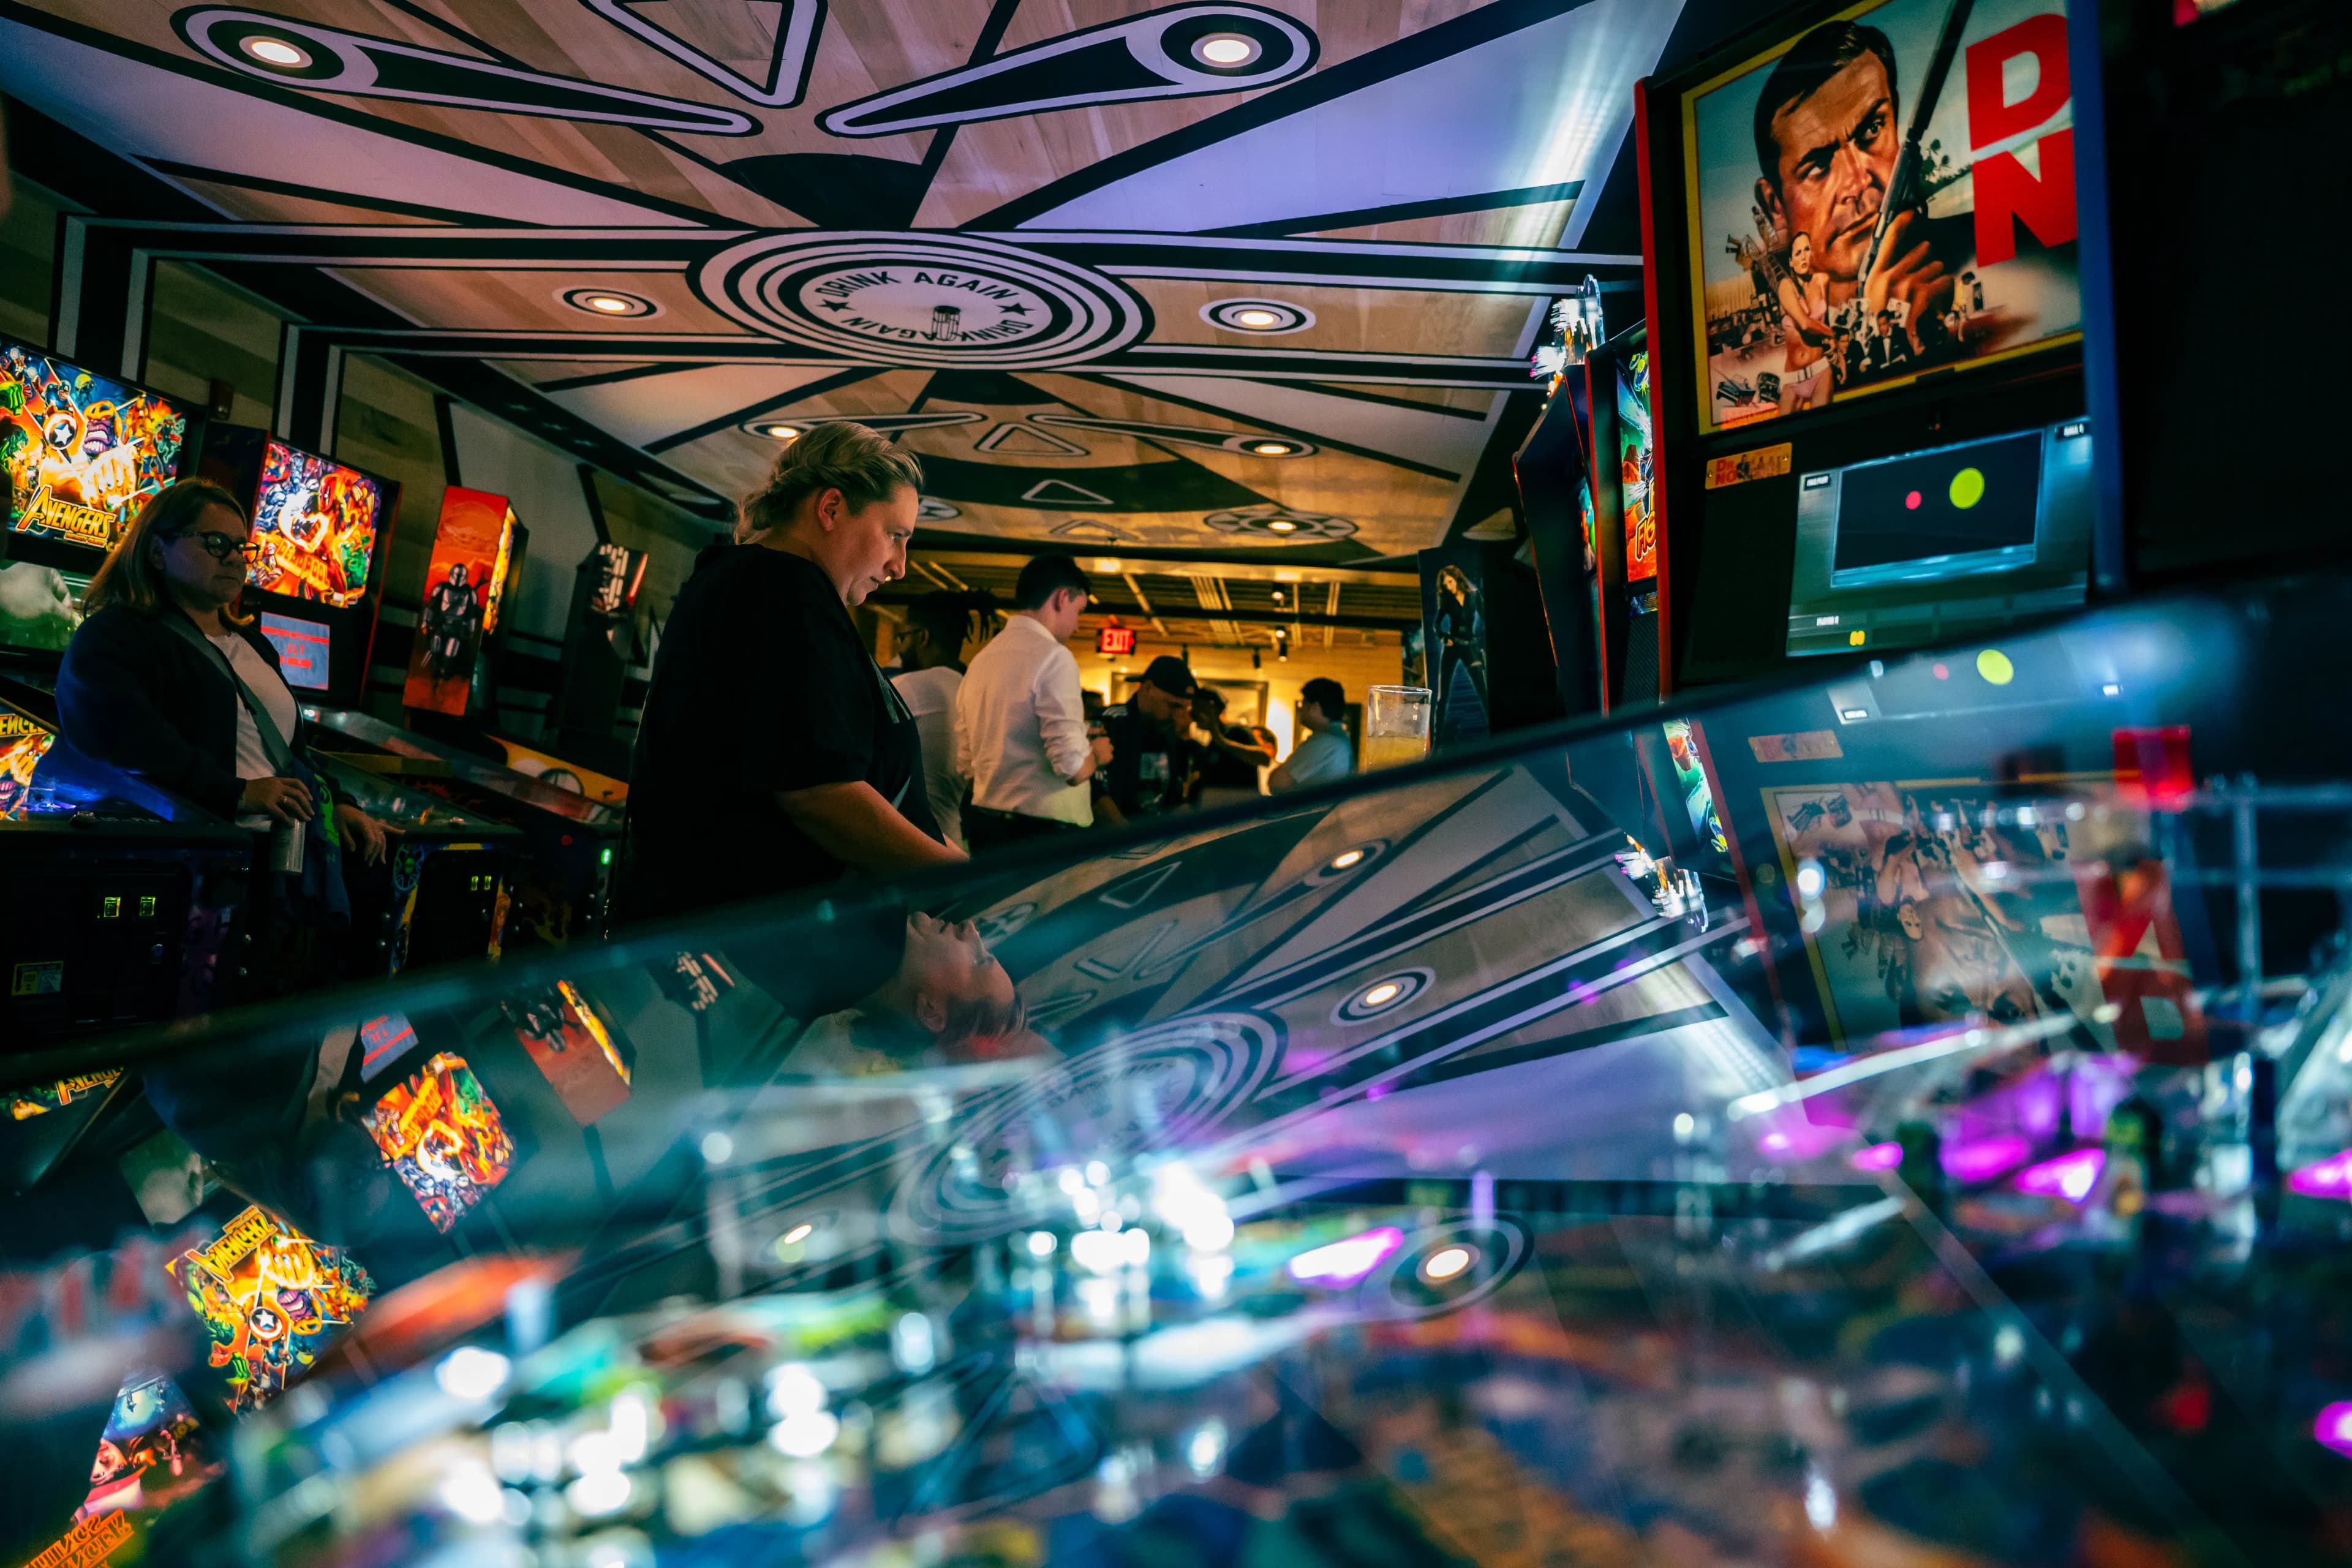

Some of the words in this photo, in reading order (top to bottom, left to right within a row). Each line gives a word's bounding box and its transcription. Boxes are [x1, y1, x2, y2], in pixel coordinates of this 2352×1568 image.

[814, 271, 902, 298] DRINK
[913, 272, 1020, 300] AGAIN
[840, 317, 938, 341] AGAIN
[951, 319, 1035, 342] DRINK
[17, 486, 115, 538] AVENGERS
